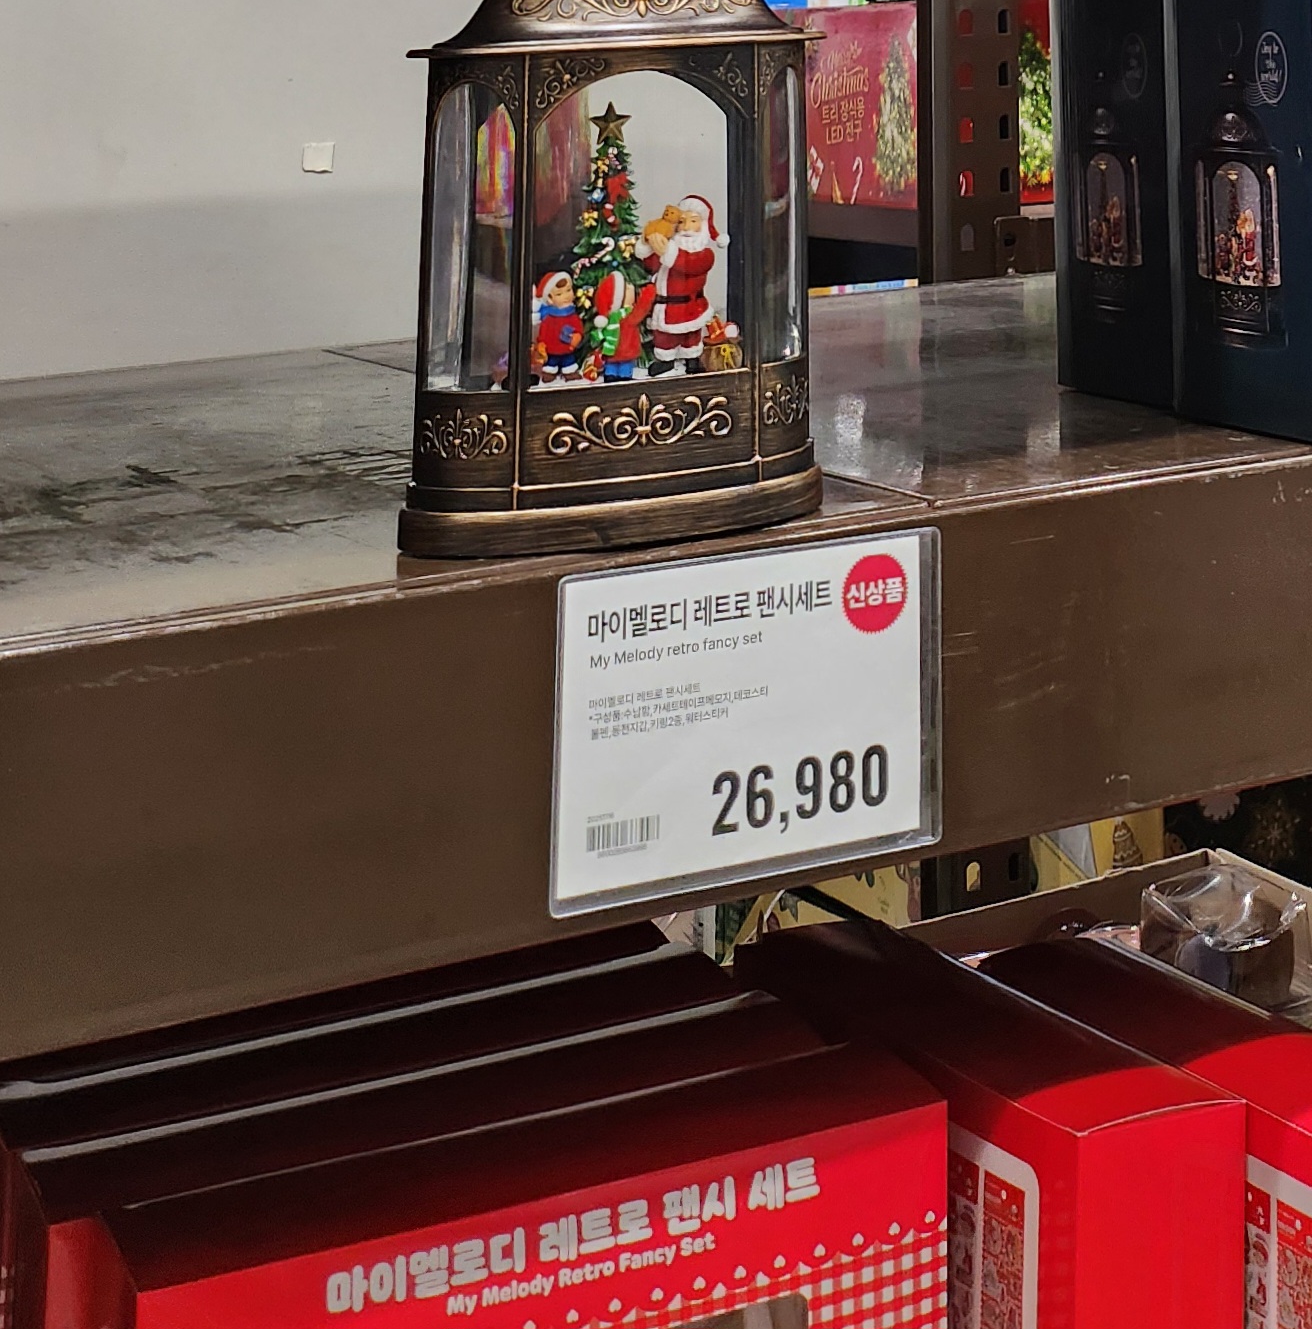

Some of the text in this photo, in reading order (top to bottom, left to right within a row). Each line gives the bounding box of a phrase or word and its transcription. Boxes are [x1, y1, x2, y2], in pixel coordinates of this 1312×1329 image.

[811, 65, 869, 108] Christmas
[822, 96, 865, 123] 트리 장식용
[826, 120, 862, 144] LED 전구
[587, 579, 833, 643] 마이멜로디 레트로 팬시세트
[846, 576, 905, 611] 신상품
[589, 629, 764, 670] My Melody retro fancy set
[588, 681, 701, 711] 마이멜로디 레트로 팬시세트
[711, 744, 889, 837] 26,980
[327, 1157, 821, 1316] 마이멜로디 레트로 팬시 세트
[446, 1231, 716, 1317] My Melody Retro Fancy Set
